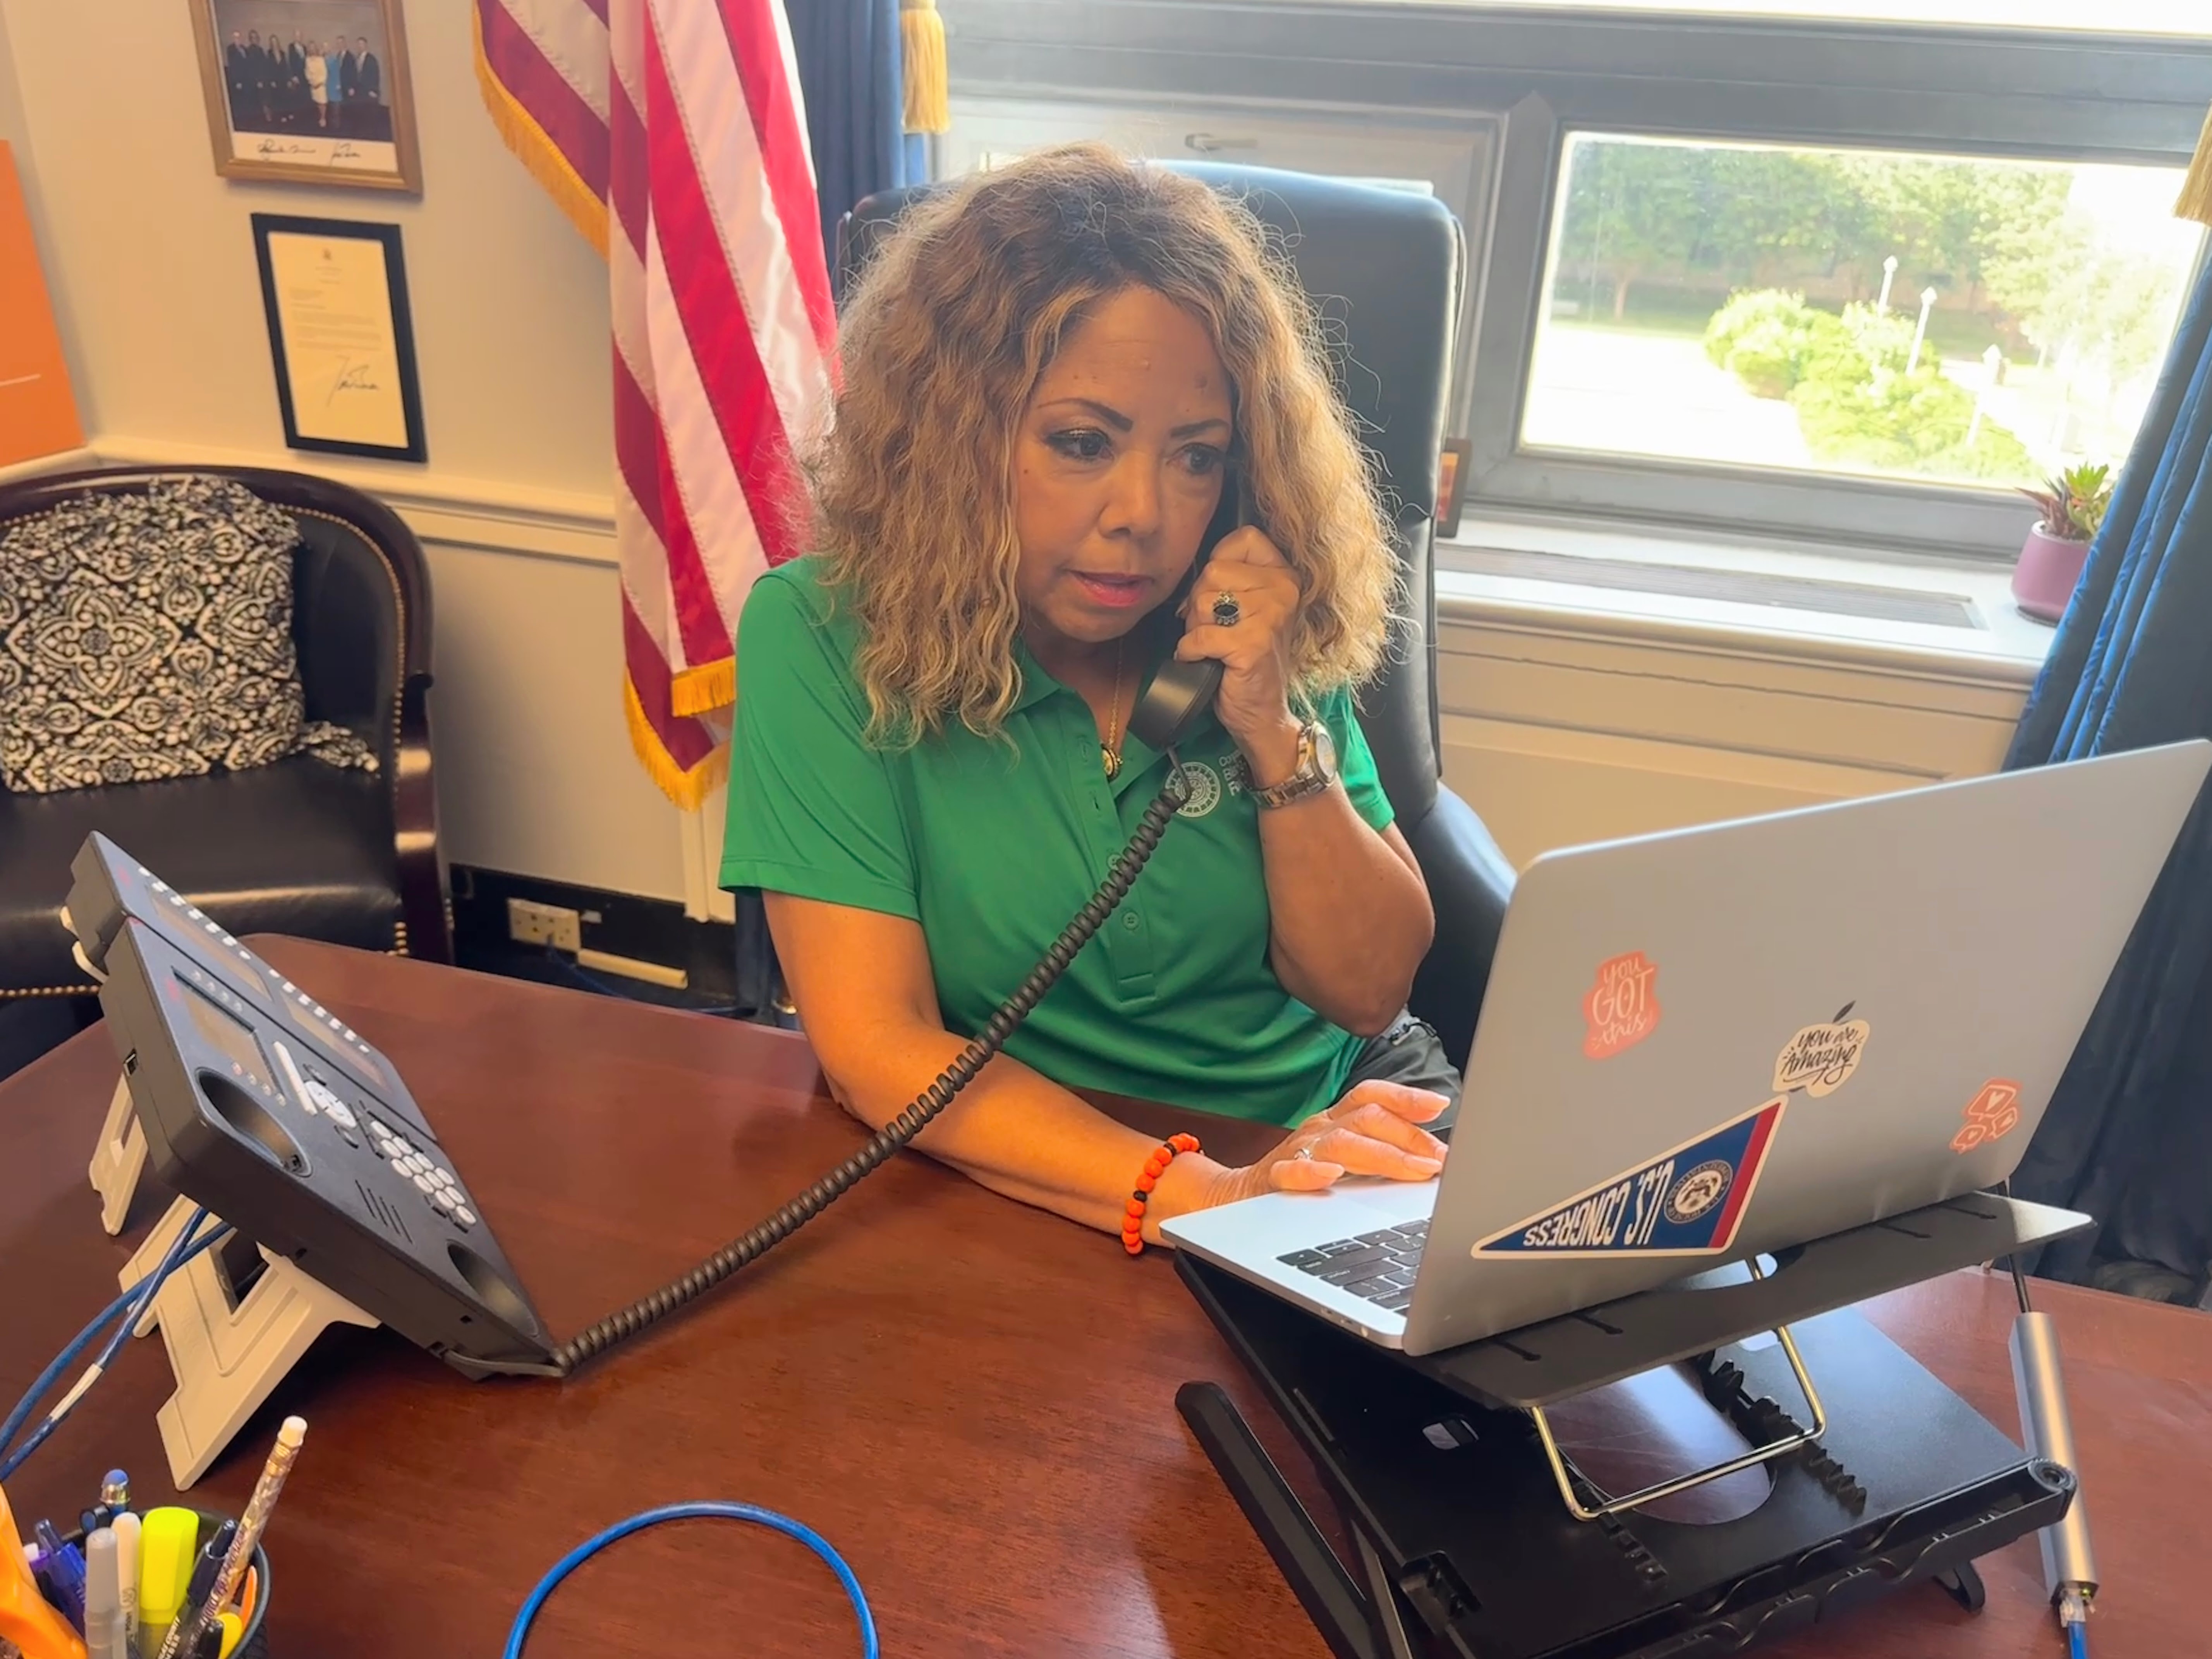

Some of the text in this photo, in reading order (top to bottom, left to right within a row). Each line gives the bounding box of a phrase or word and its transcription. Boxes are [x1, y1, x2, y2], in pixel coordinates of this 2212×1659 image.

[1592, 967, 1655, 1025] GOT
[1604, 957, 1642, 997] you
[1600, 1012, 1647, 1045] this
[1797, 1027, 1858, 1054] you are
[1523, 1181, 1631, 1247] CONGRESS
[1624, 1159, 1675, 1245] U.S.
